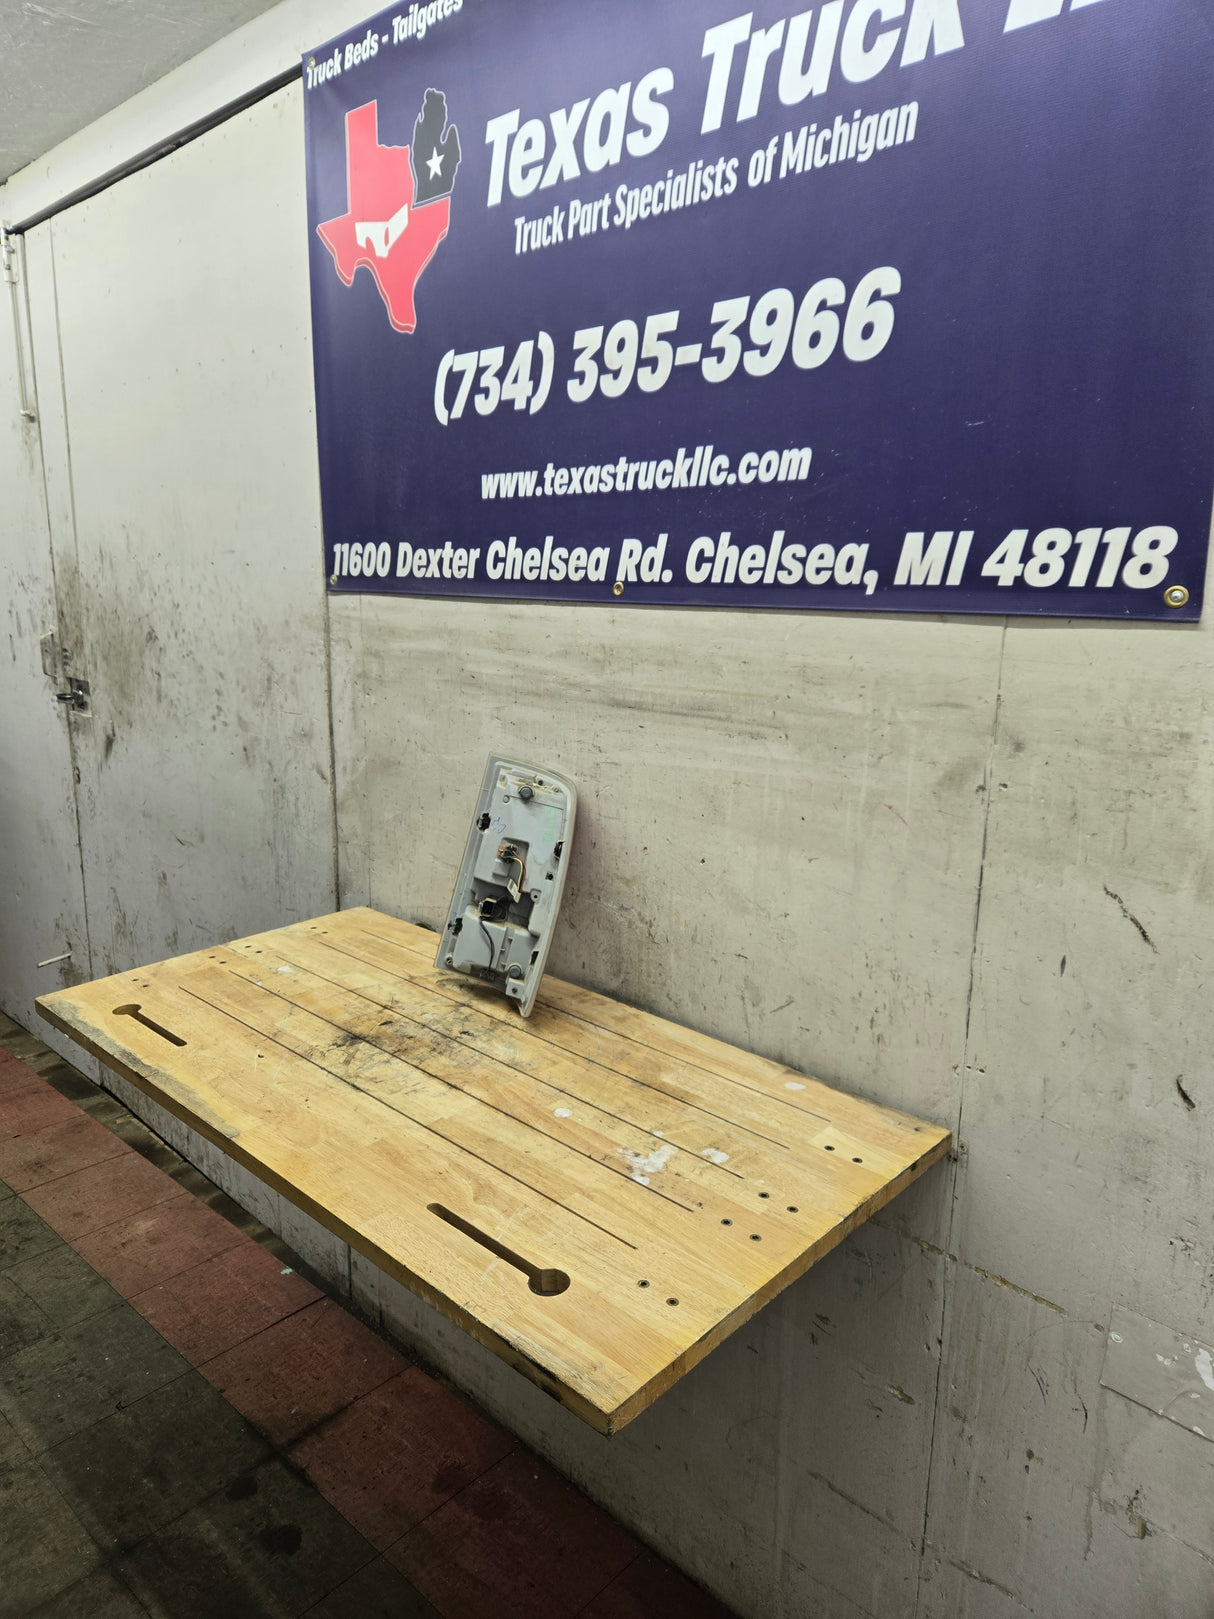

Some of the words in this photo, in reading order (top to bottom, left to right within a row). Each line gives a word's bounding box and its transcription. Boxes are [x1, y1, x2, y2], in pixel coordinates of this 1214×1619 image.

[307, 48, 343, 90] Truck
[344, 29, 379, 71] Beds
[392, 0, 464, 45] Tailgates
[485, 67, 674, 208] Texas
[514, 205, 565, 255] Truck
[568, 192, 612, 241] Part
[614, 156, 739, 230] Specialists
[747, 135, 779, 188] of
[779, 100, 919, 180] Michigan
[434, 331, 555, 426] (734)
[567, 266, 901, 402] 395-3966
[481, 445, 813, 499] www.texastruckllc.com
[332, 542, 391, 579] 11600
[397, 541, 480, 578] Dexter
[486, 536, 611, 582] Chelsea
[616, 533, 673, 583] Rd.
[685, 530, 878, 596] Chelsea,
[894, 531, 974, 586] MI
[981, 525, 1178, 588] 48118
